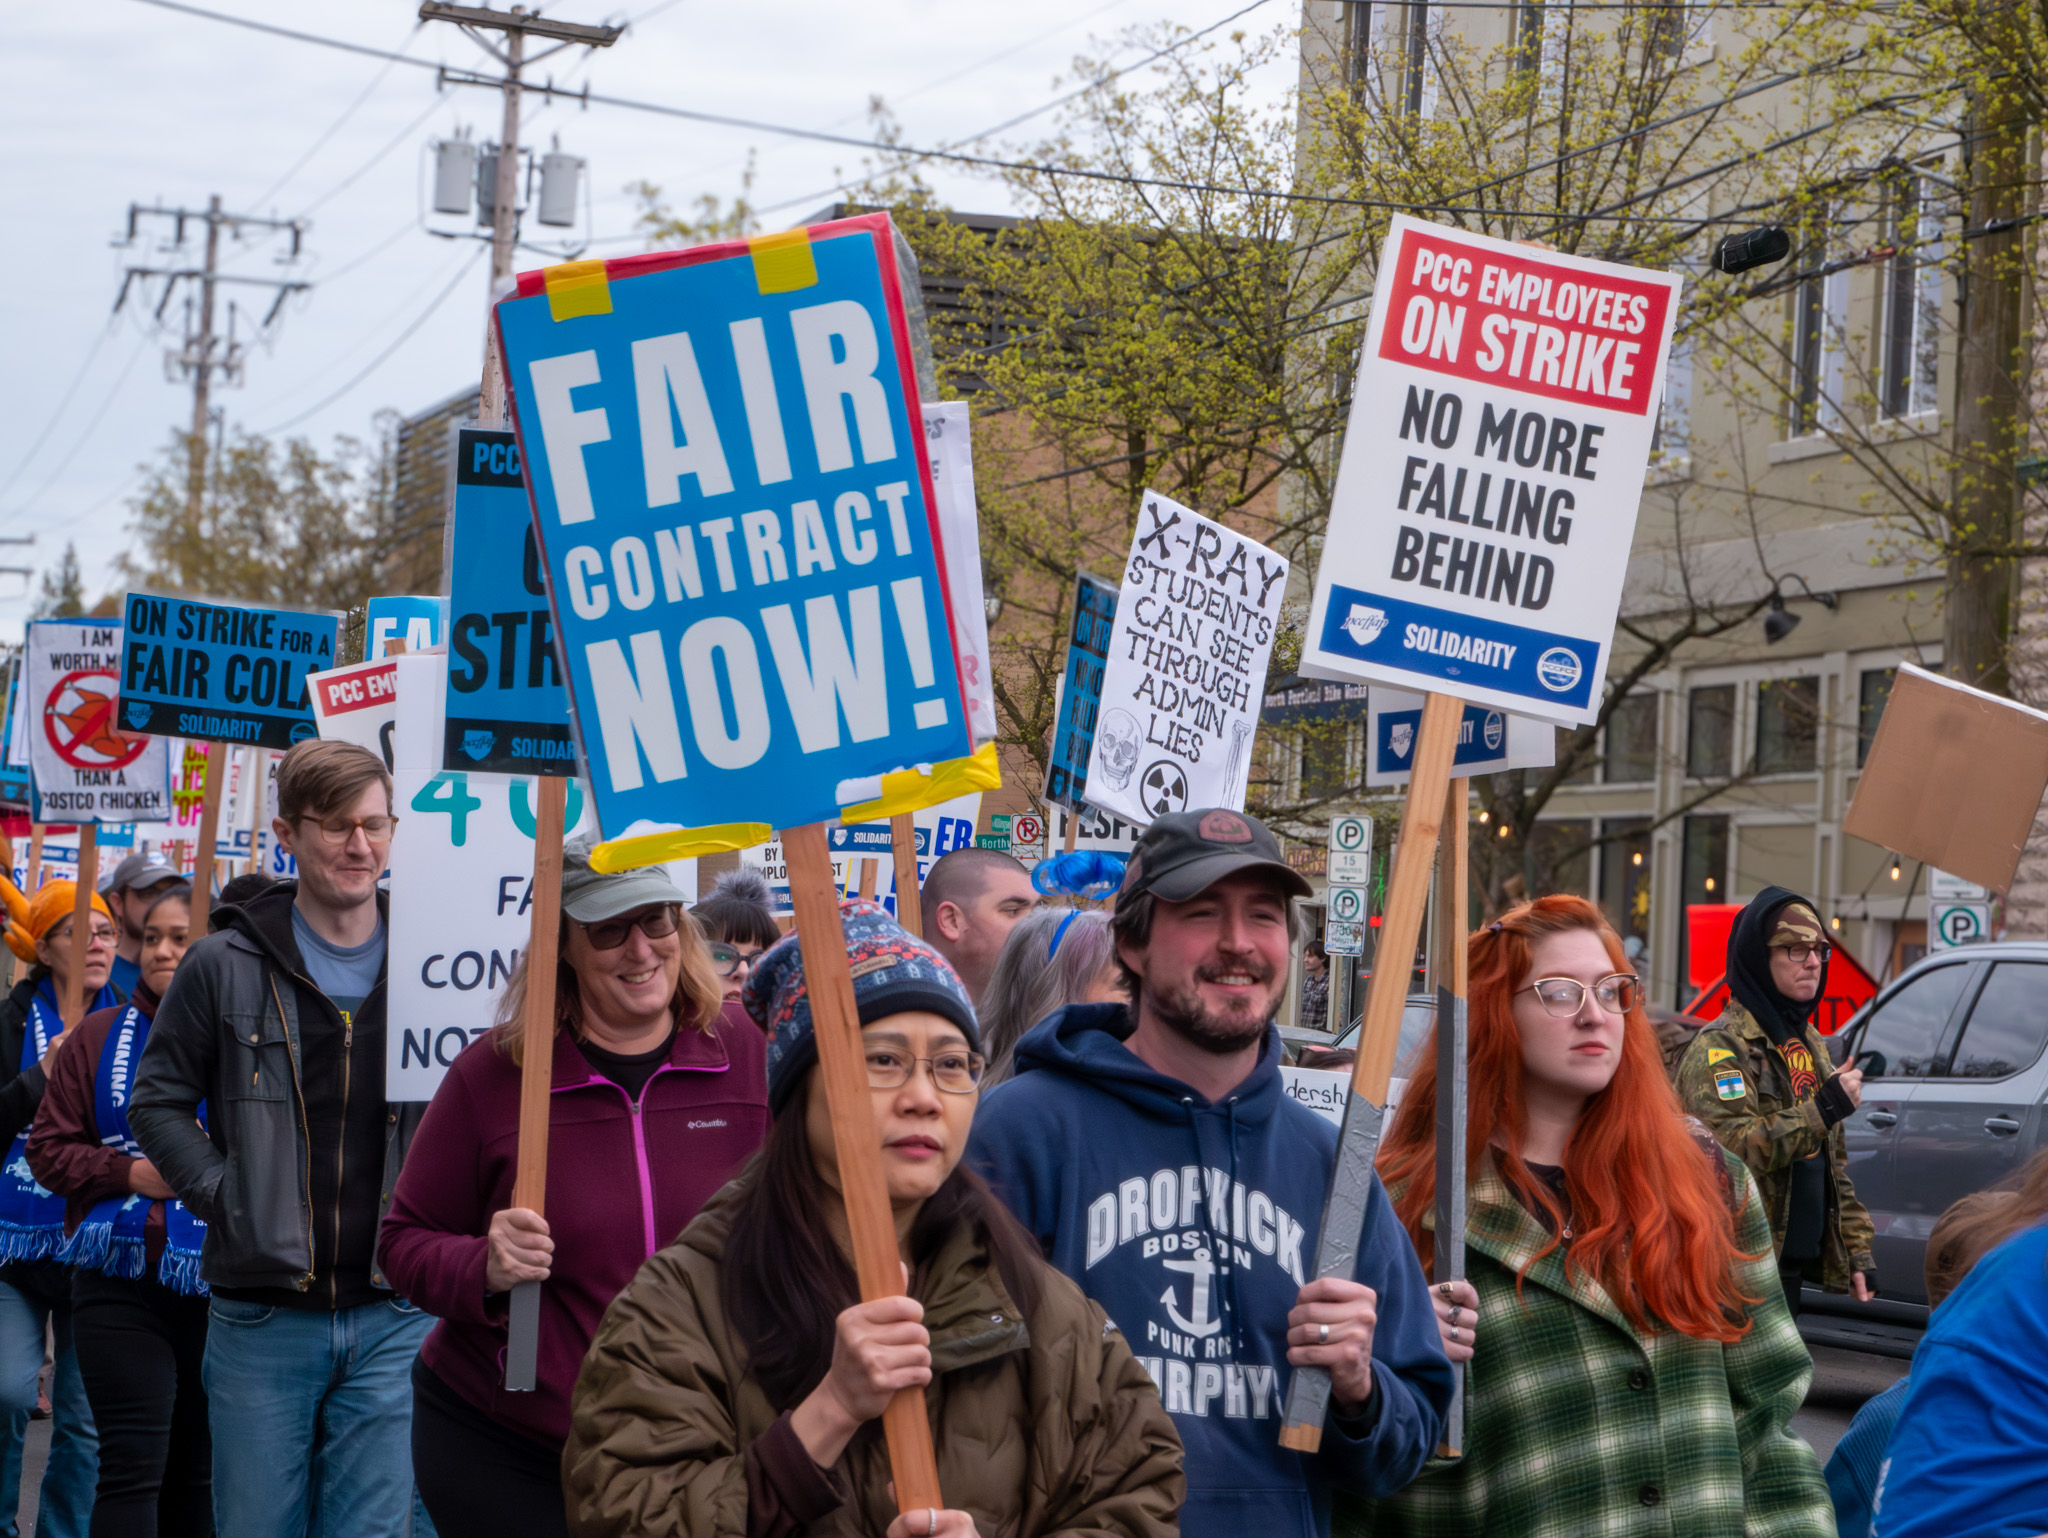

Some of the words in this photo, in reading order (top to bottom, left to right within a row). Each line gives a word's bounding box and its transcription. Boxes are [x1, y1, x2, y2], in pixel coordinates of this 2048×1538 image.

[1411, 248, 1472, 298] PCC
[1478, 265, 1649, 335] EMPLOYEES
[1401, 294, 1467, 363] ON
[1475, 314, 1641, 400] STRIKE
[528, 300, 898, 526] FAIR
[1399, 384, 1463, 450] NO
[1474, 402, 1605, 481] MORE
[473, 442, 521, 475] PCC
[1397, 455, 1576, 547] FALLING
[564, 480, 913, 621] CONTRACT
[1139, 502, 1285, 608] X-RAY
[1390, 525, 1554, 611] BEHIND
[130, 598, 167, 637] ON
[176, 604, 276, 649] STRIKE
[280, 629, 313, 654] FOR
[318, 634, 329, 656] A
[1128, 555, 1272, 645] STUDENTS
[50, 653, 100, 671] WORTH
[82, 629, 86, 647] I
[92, 629, 113, 647] AM
[1135, 596, 1203, 648] CAN
[1210, 629, 1254, 676] SEE
[1403, 623, 1517, 670] SOLIDARITY
[126, 641, 210, 700] FAIR
[224, 653, 320, 712] COLA
[328, 681, 364, 707] PCC
[584, 576, 948, 794] NOW!
[1126, 626, 1251, 713] THROUGH
[178, 713, 263, 741] SOLIDARITY
[1132, 672, 1226, 739] ADMIN
[1146, 713, 1203, 764] LIES
[74, 769, 111, 786] THAN
[117, 769, 126, 786] A
[100, 792, 160, 809] CHICKEN
[765, 848, 777, 861] BY
[1344, 855, 1356, 866] 15
[1345, 826, 1358, 844] P
[1953, 916, 1971, 940] P
[1086, 1165, 1306, 1288] DROPKICK
[1143, 1230, 1251, 1271] BOSON
[1148, 1320, 1196, 1358] PUNK
[1205, 1336, 1244, 1359] ROC
